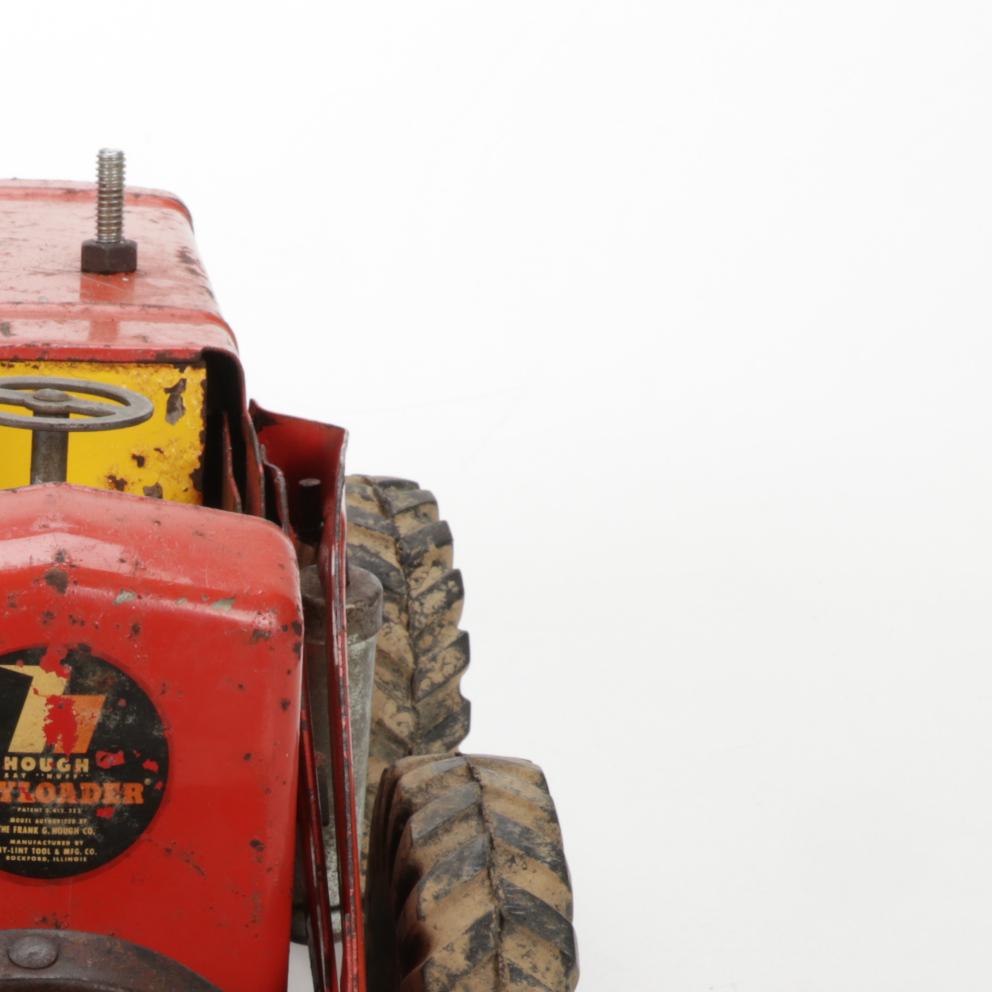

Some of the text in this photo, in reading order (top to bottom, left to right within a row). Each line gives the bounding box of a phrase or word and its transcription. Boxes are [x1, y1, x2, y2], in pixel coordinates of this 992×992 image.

[3, 756, 89, 773] HOUGH
[12, 825, 39, 834] FRANK
[42, 826, 50, 834] G.
[51, 826, 80, 835] HOUGH
[82, 827, 96, 836] CO.
[31, 847, 51, 856] TOOL
[54, 848, 61, 856] &
[63, 848, 83, 856] MFG.
[84, 848, 98, 856] CO.
[5, 855, 50, 863] ROCKFORD,
